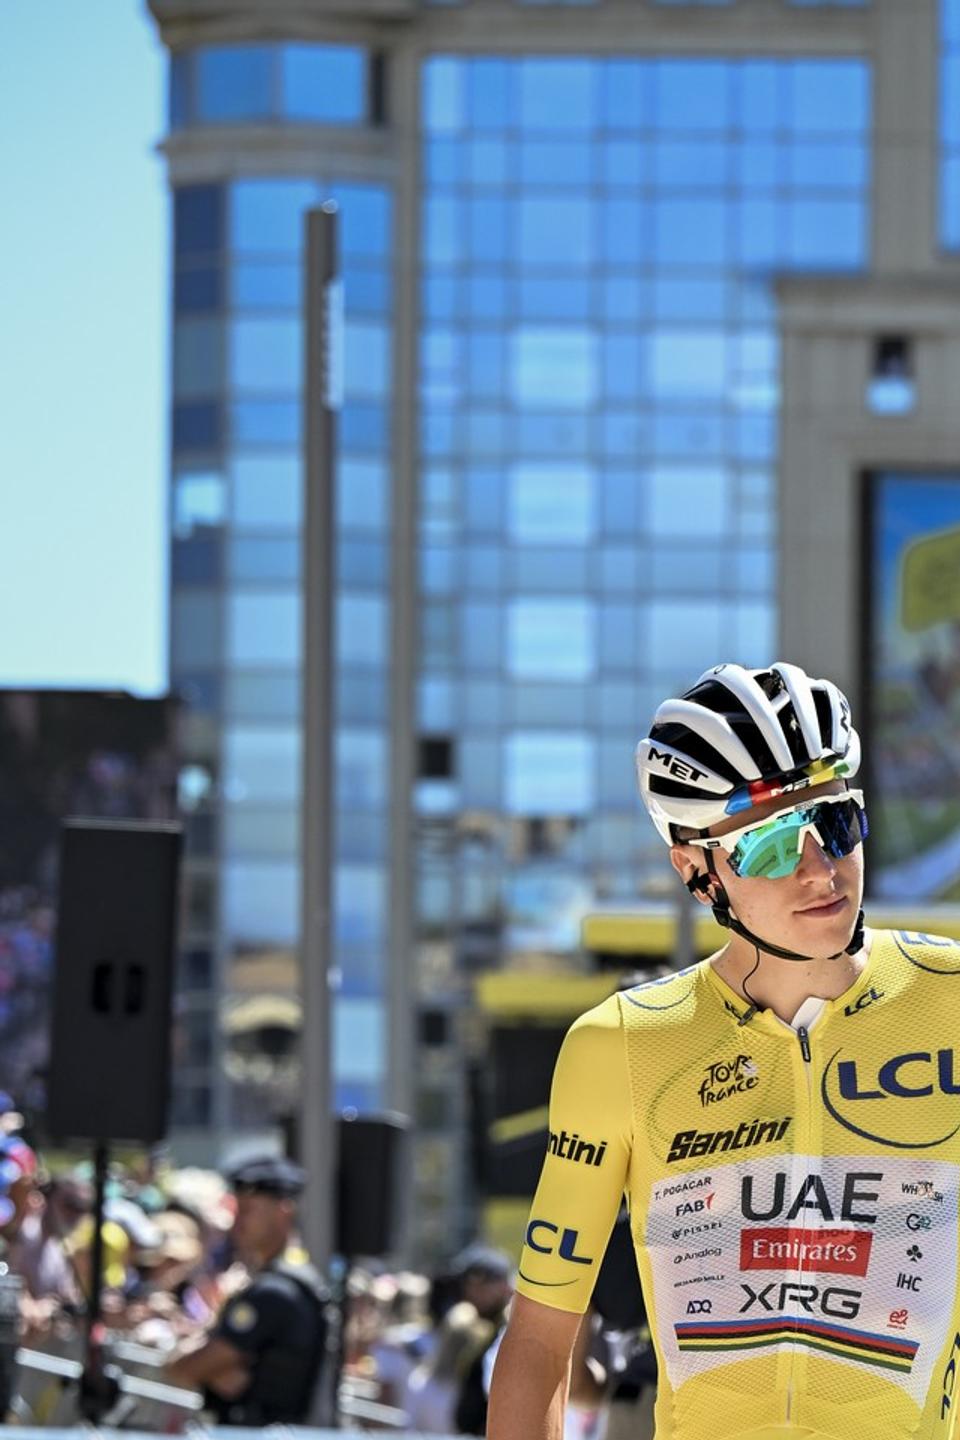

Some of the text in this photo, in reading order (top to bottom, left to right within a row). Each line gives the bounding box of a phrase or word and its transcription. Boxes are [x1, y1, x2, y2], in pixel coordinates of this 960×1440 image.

[647, 746, 709, 783] MET
[844, 987, 885, 1017] LCL
[547, 1131, 608, 1167] ntini
[666, 1116, 793, 1164] Santini
[675, 1199, 706, 1217] FAB
[741, 1172, 884, 1224] UAE
[525, 1218, 594, 1266] CL
[752, 1237, 858, 1263] Emirates
[896, 1272, 923, 1292] IHC
[686, 1299, 713, 1314] ADQ
[739, 1282, 862, 1320] XRG
